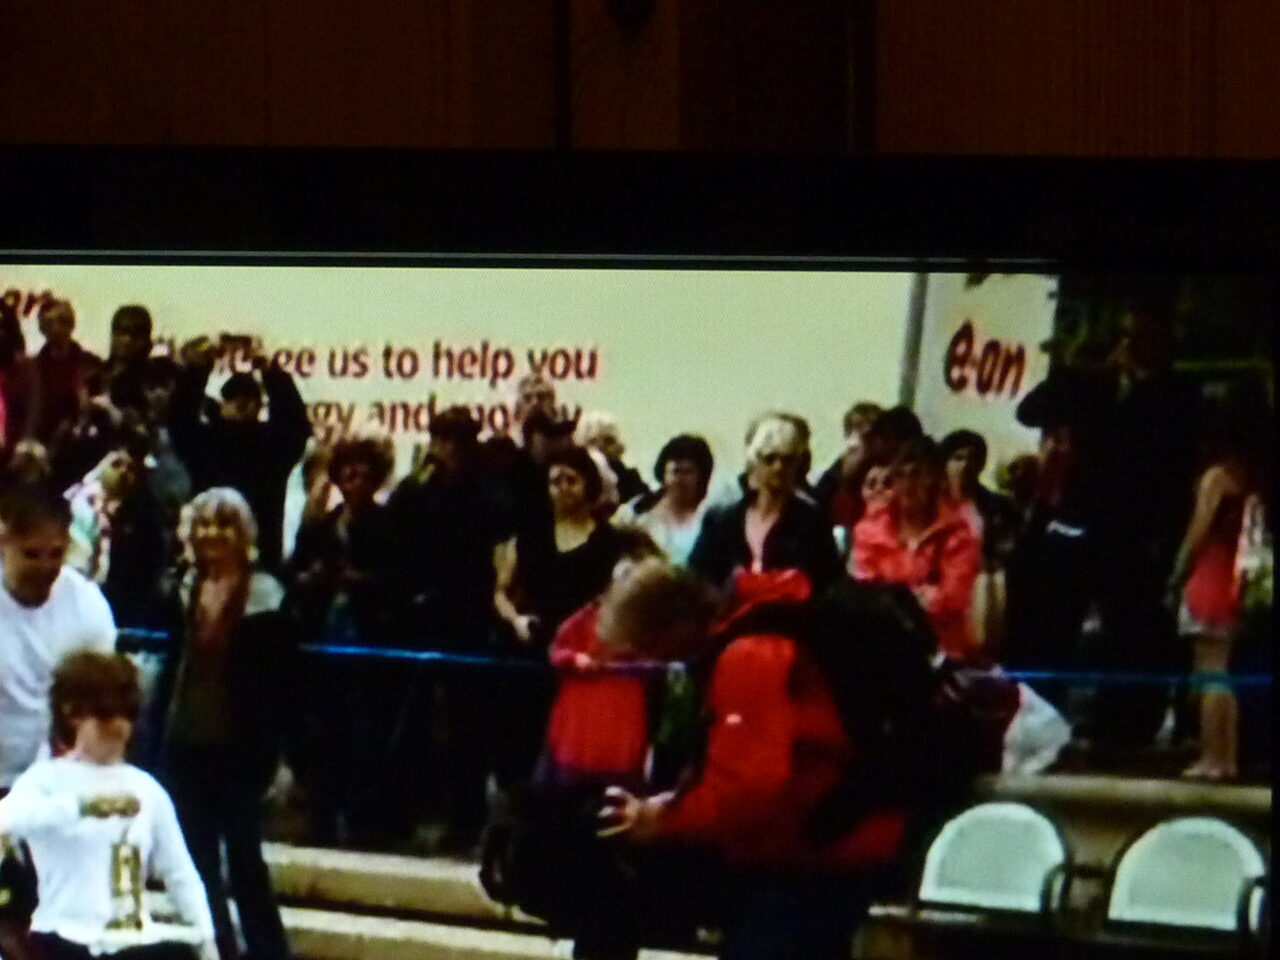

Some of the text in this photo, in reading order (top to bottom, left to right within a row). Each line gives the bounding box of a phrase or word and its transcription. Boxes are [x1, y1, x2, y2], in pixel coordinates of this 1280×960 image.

[328, 347, 369, 379] us
[383, 343, 420, 379] to
[433, 339, 516, 387] help
